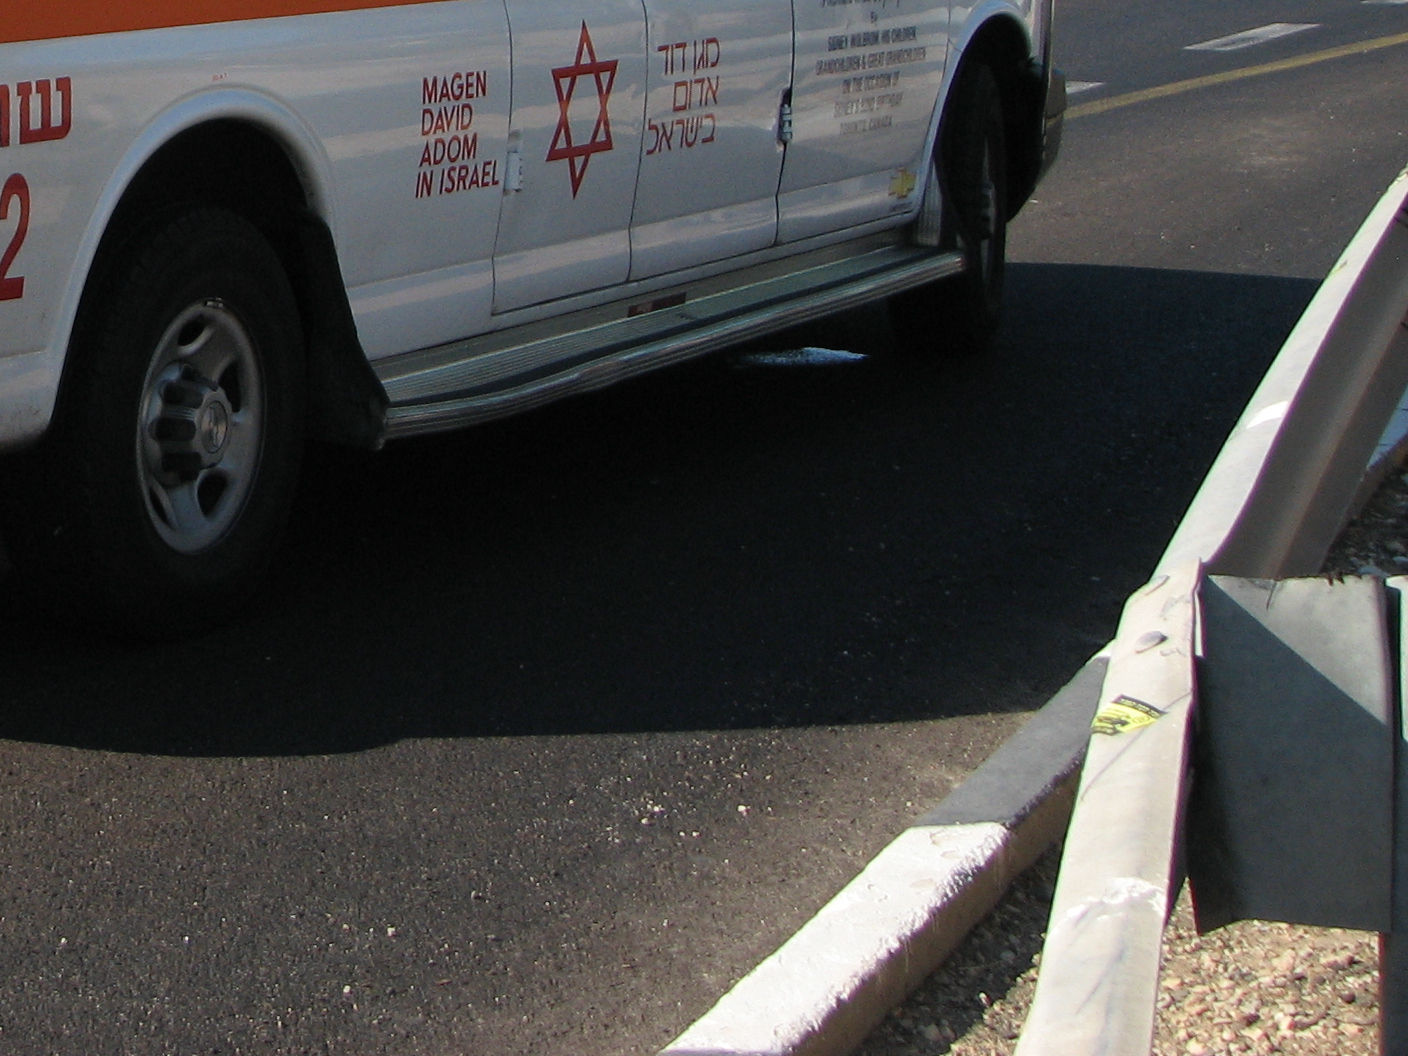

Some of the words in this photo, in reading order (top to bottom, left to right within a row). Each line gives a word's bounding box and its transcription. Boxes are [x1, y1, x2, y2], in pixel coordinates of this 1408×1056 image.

[657, 42, 687, 75] דוד
[694, 37, 720, 75] מגן
[422, 70, 487, 105] MAGEN
[673, 75, 719, 112] אדום
[421, 103, 473, 136] DAVID
[646, 113, 715, 155] בישראל
[419, 132, 478, 167] ADOM
[415, 170, 434, 198] IN
[439, 160, 499, 195] ISRAEL
